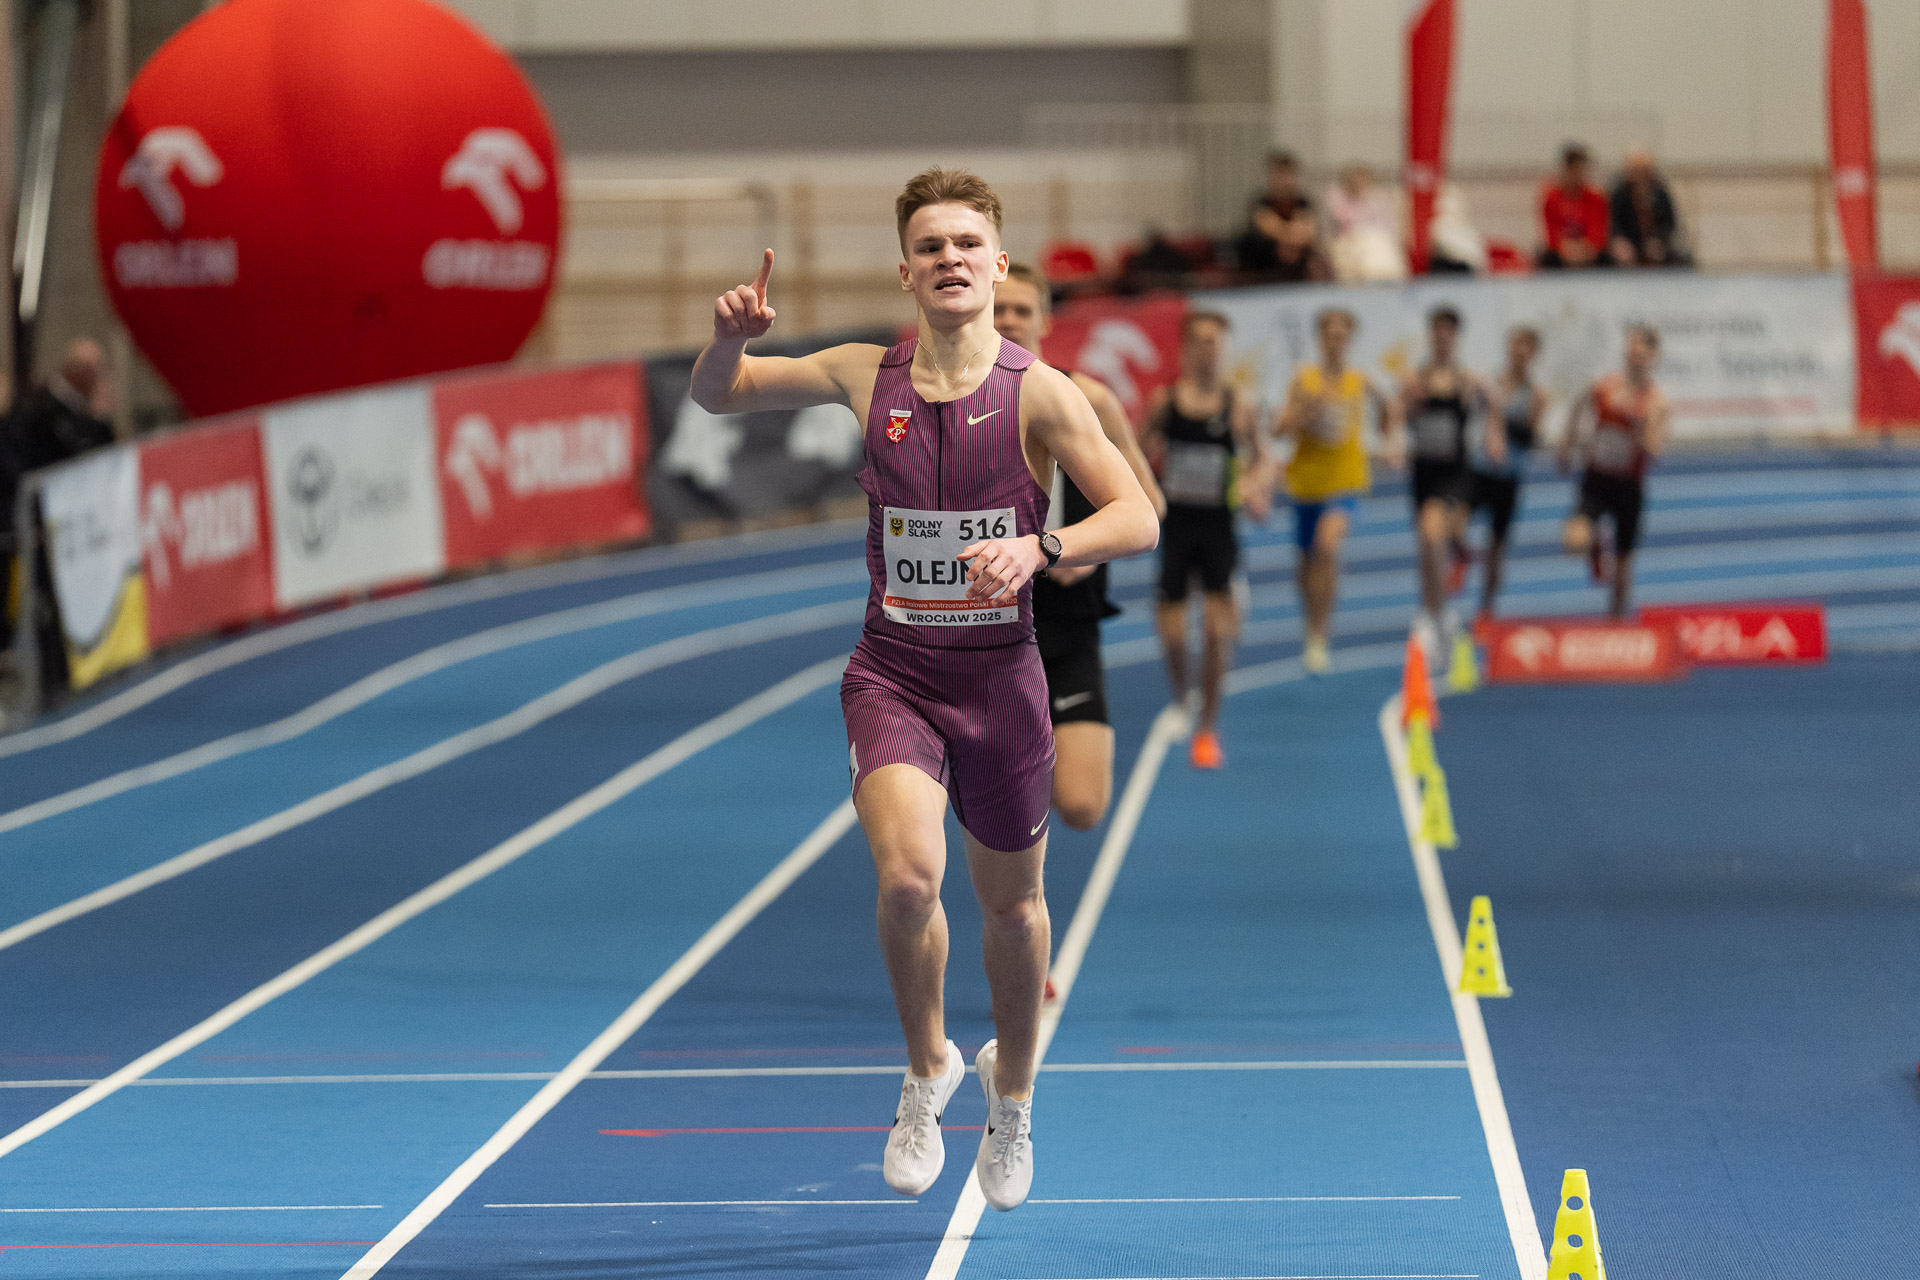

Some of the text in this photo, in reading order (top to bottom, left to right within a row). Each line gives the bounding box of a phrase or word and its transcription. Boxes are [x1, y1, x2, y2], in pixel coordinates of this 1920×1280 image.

[908, 519, 943, 529] DOLNY
[959, 516, 1007, 541] 516
[896, 559, 988, 585] OLEJN
[906, 612, 1002, 623] WROCŁAW 2025
